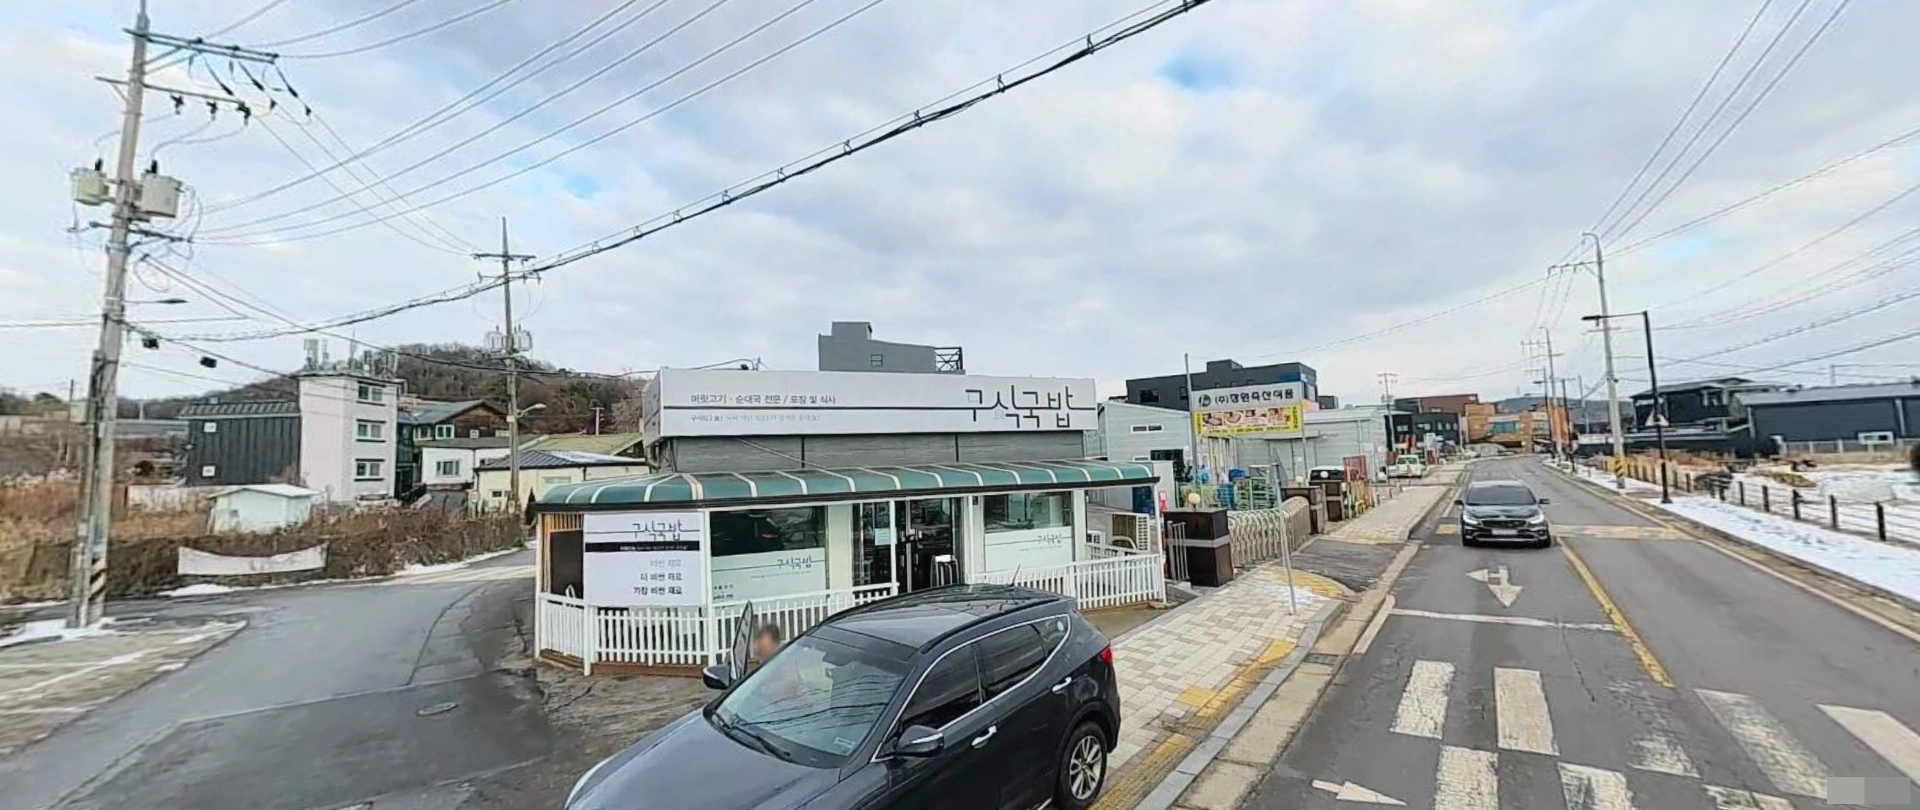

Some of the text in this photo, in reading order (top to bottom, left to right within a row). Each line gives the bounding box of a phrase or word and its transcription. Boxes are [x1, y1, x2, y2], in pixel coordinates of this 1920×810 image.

[690, 394, 727, 405] 머릿고기
[735, 394, 762, 405] 순대국
[764, 394, 781, 405] 전문
[789, 394, 807, 405] 포장
[809, 394, 818, 405] 및
[820, 394, 837, 405] 식사
[965, 385, 1075, 428] 구식국밥
[632, 519, 684, 541] 구식국밥
[640, 573, 648, 581] 더
[668, 572, 683, 581] 재료
[633, 586, 648, 595] 가장
[668, 586, 683, 595] 재료
